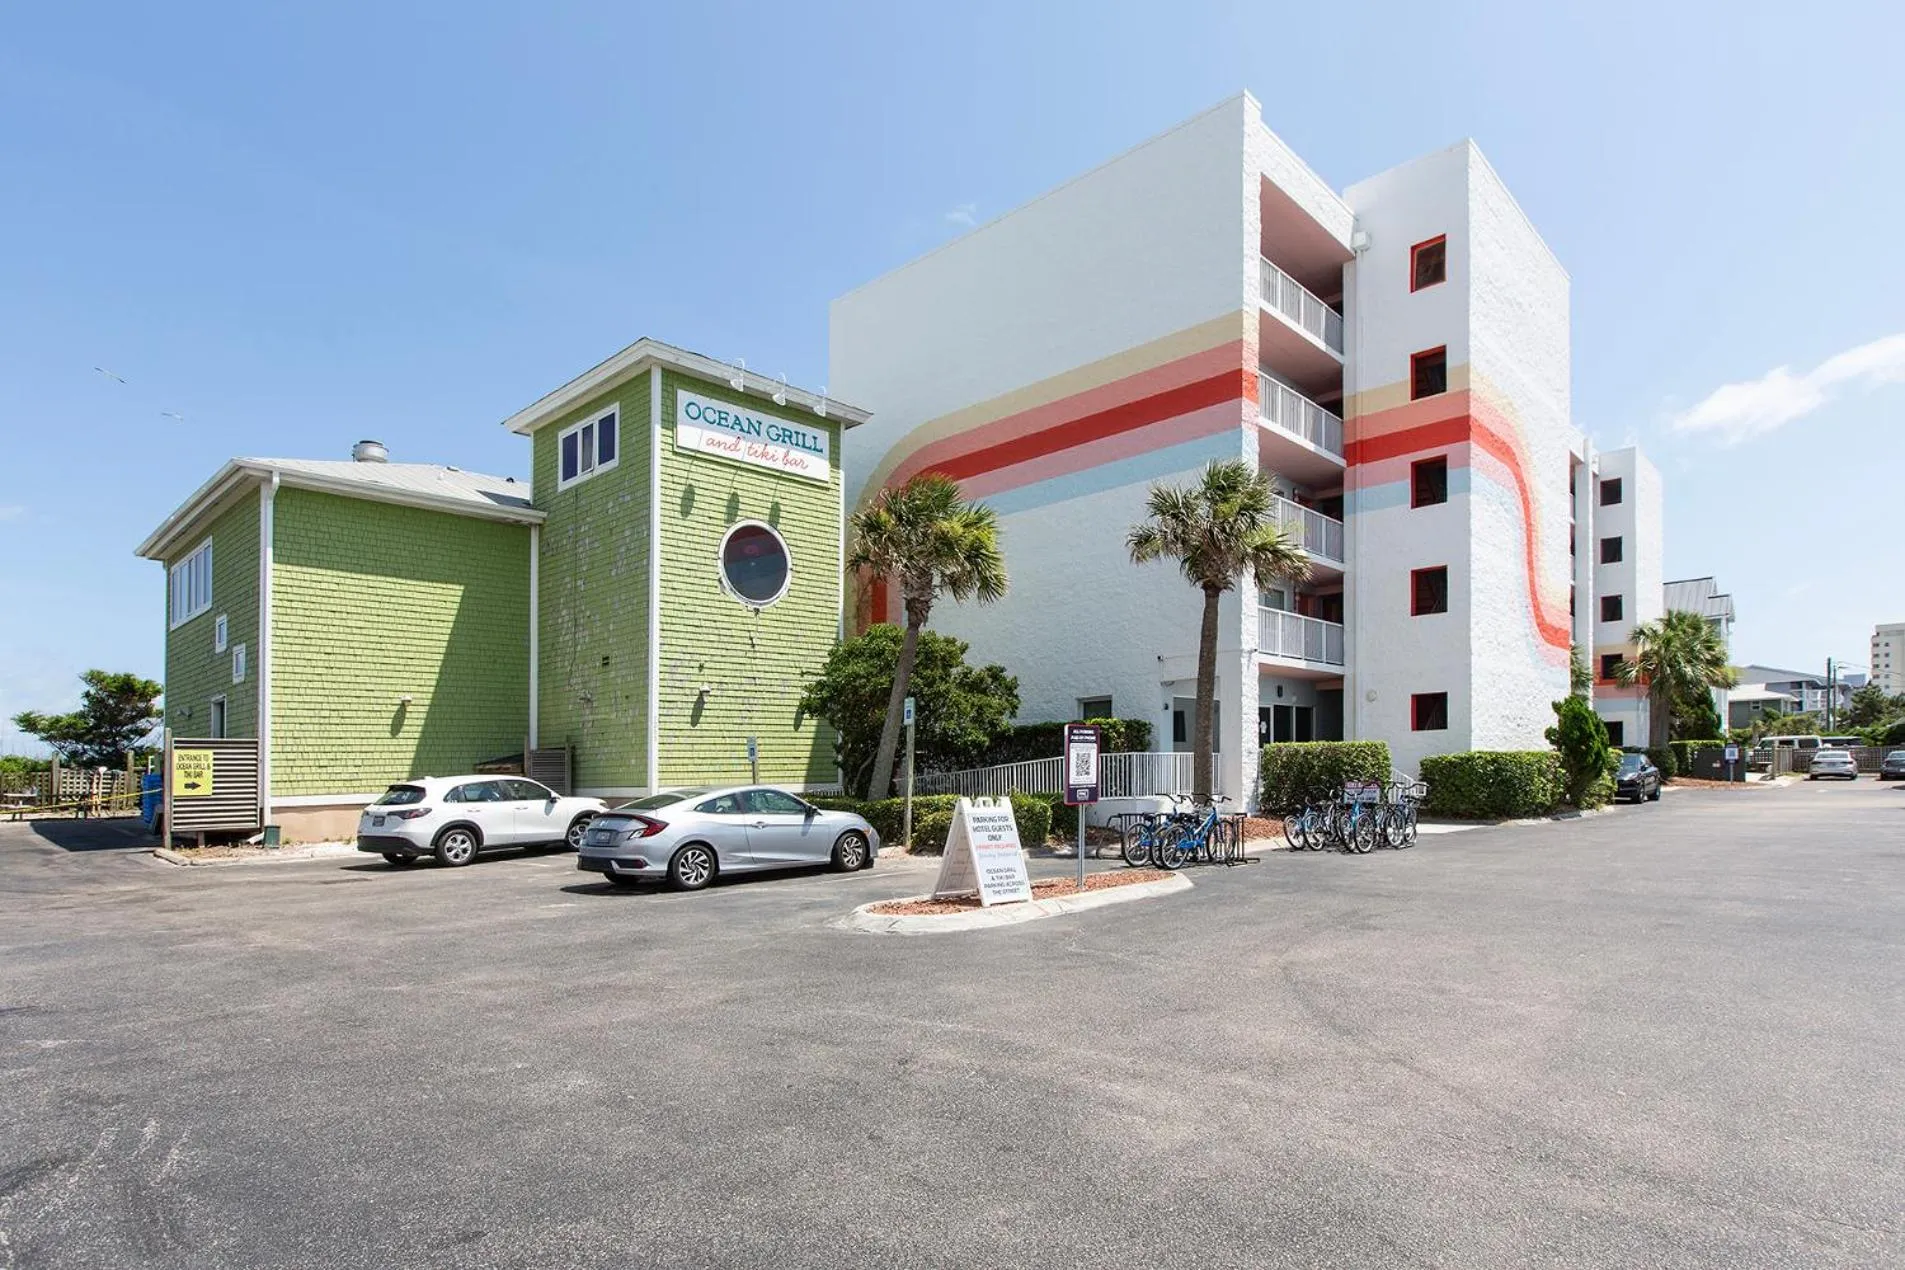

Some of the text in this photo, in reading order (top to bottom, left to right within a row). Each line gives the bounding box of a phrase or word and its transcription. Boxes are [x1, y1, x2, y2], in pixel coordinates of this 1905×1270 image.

[684, 401, 824, 453] OCEAN GRILL
[706, 436, 809, 470] and tiki bar
[176, 762, 192, 770] OCEAN
[193, 762, 206, 770] GRILL
